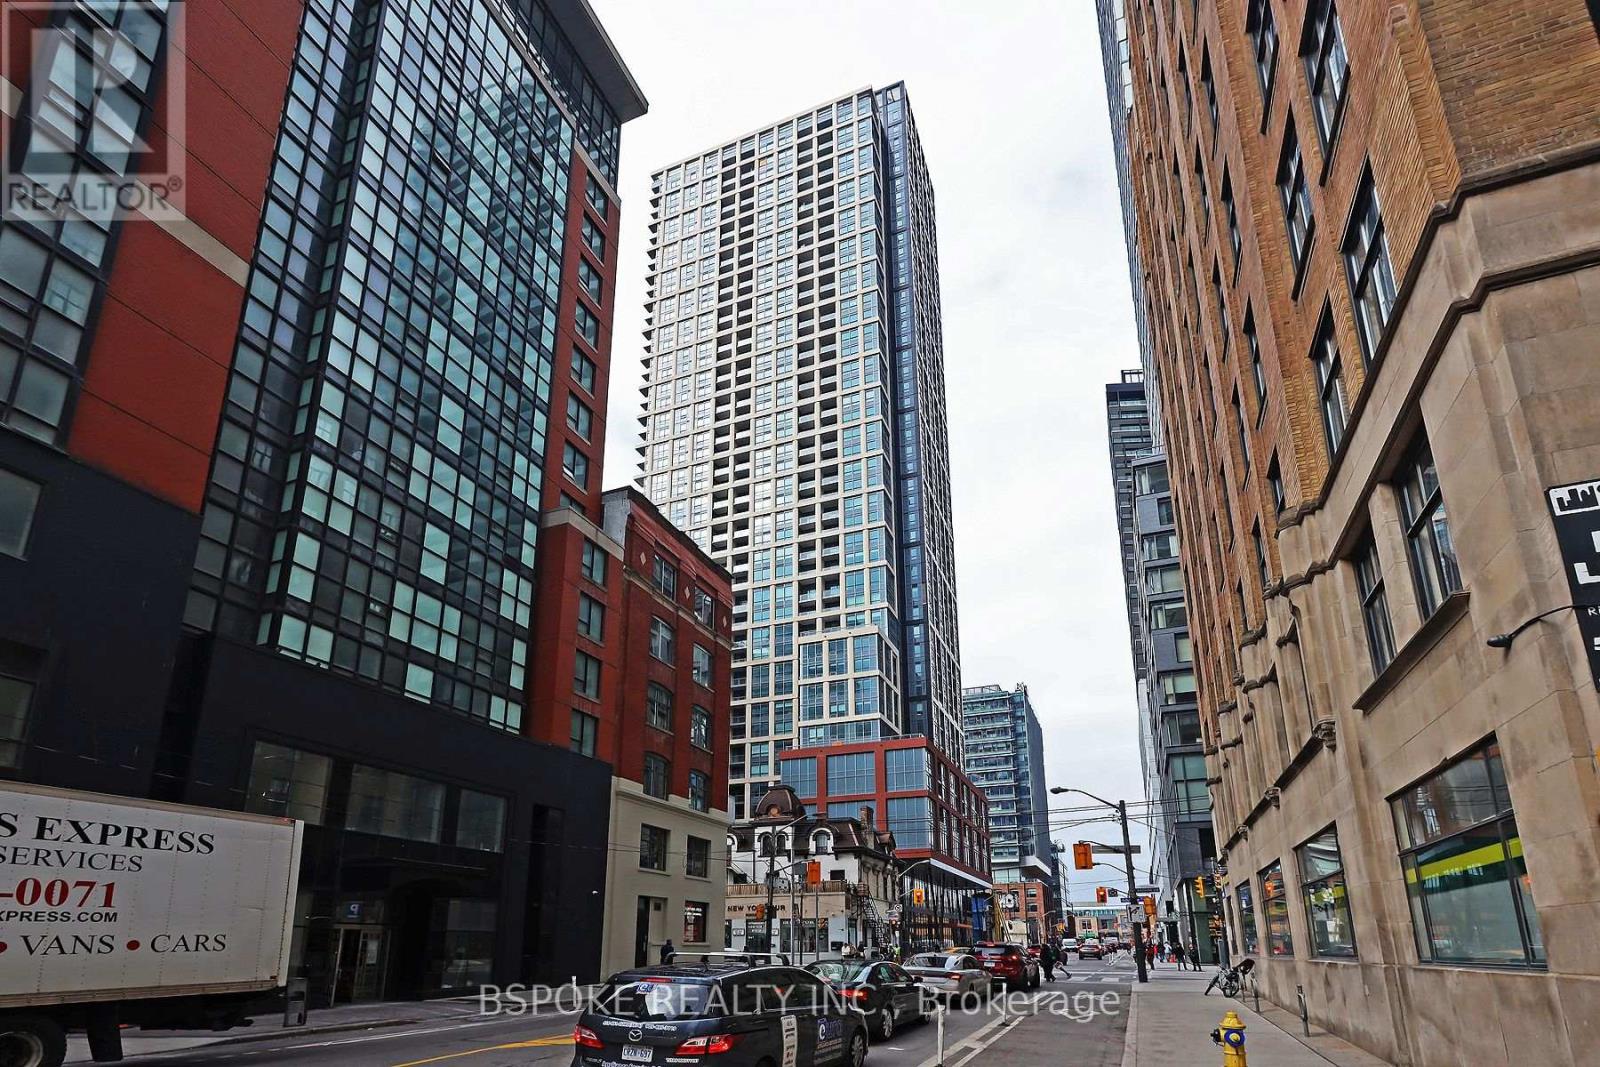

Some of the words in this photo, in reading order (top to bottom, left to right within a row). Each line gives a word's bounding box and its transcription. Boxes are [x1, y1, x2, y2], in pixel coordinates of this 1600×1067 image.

[32, 816, 214, 855] EXPRESS
[20, 934, 117, 956] VANS
[150, 934, 227, 954] CARS
